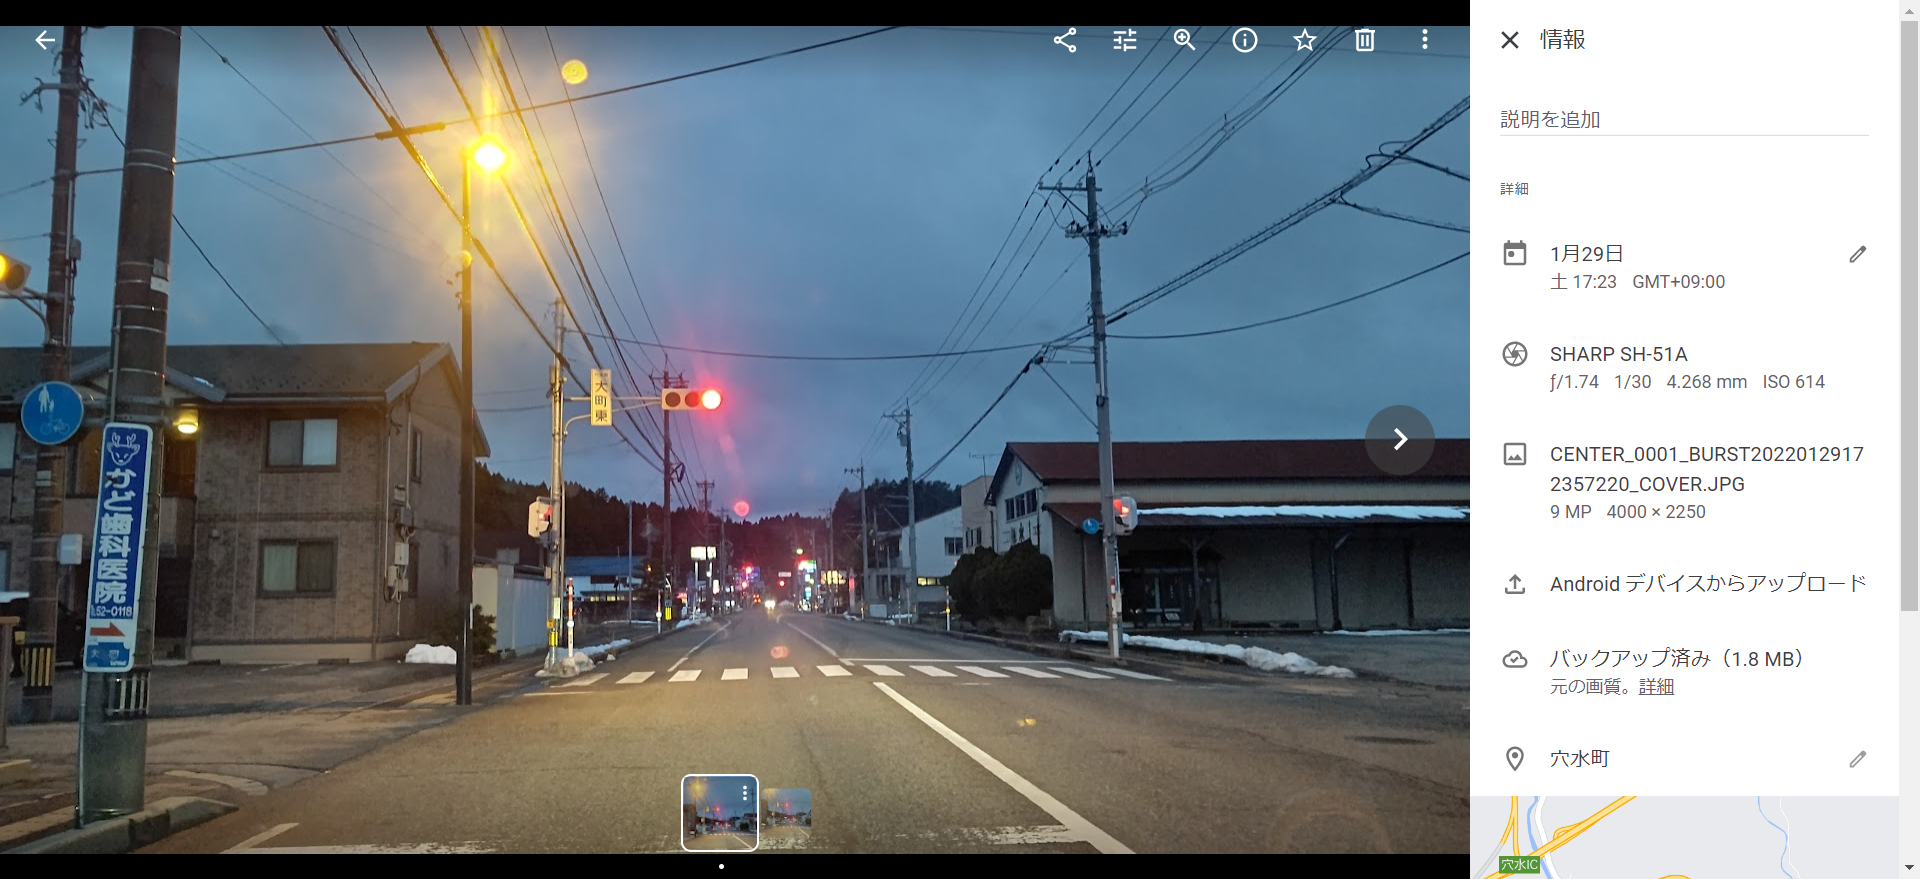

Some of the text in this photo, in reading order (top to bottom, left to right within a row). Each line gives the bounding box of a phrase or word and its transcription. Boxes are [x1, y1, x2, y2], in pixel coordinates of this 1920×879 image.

[595, 380, 608, 422] 大町東
[94, 467, 137, 604] かど歯科医院
